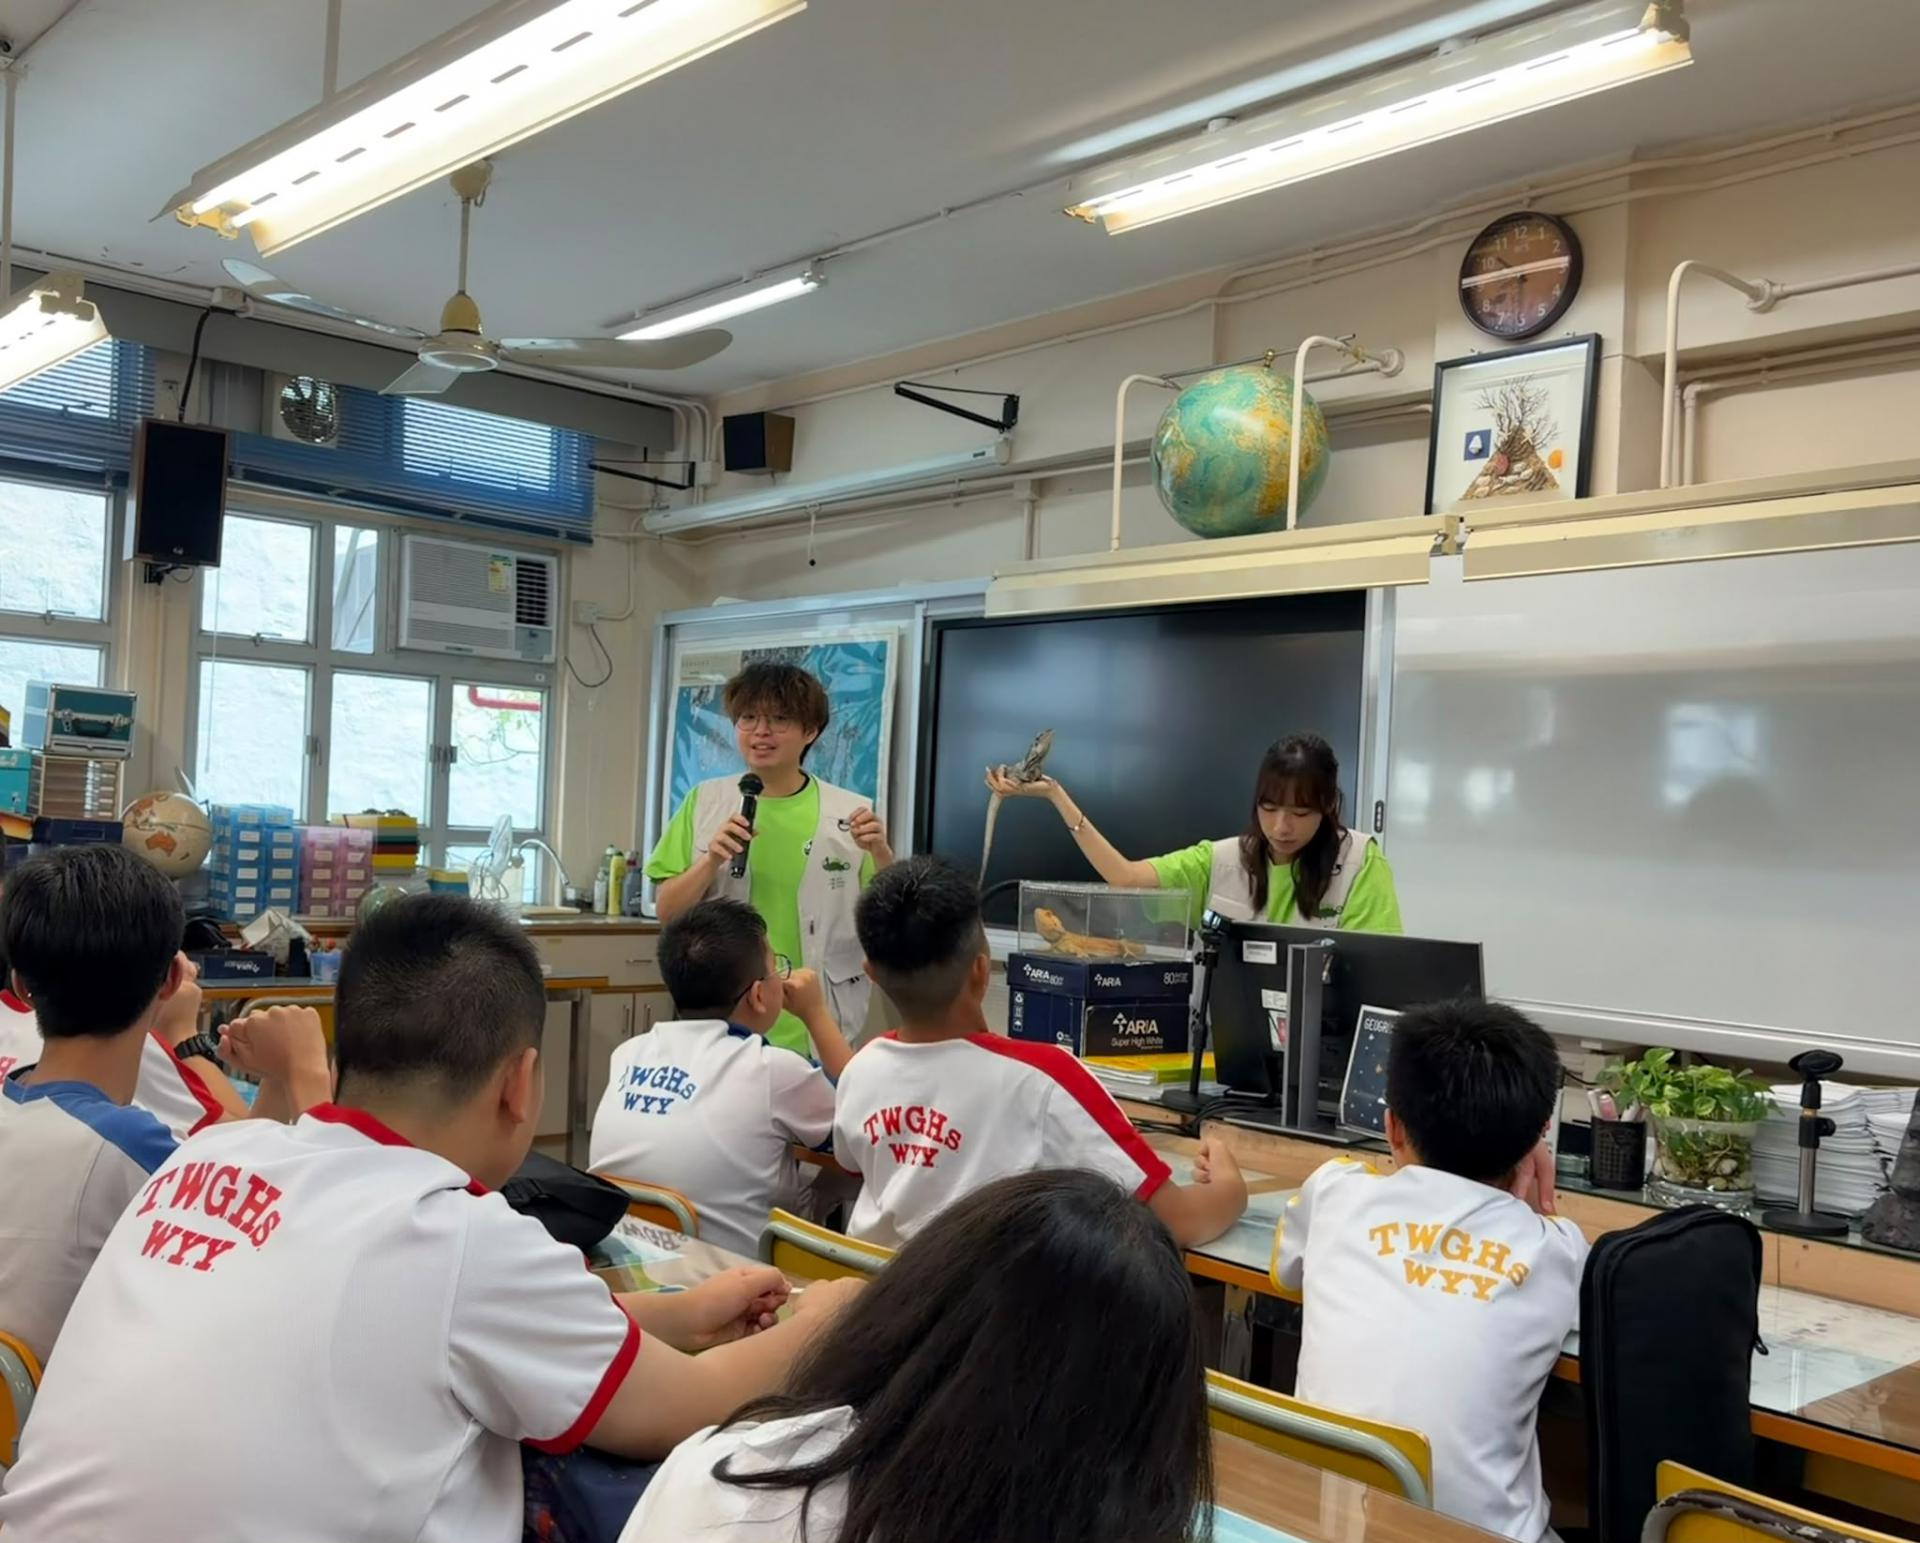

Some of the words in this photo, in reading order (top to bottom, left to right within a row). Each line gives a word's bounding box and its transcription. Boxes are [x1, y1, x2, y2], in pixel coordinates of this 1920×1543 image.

[1514, 225, 1528, 239] 12
[1496, 237, 1508, 251] 11
[1552, 240, 1561, 253] 2
[1481, 257, 1495, 270] 10
[1482, 299, 1491, 312] 8
[1538, 303, 1547, 317] 5
[1101, 976, 1122, 988] ARIA
[1125, 1018, 1159, 1036] ARIA
[1111, 1037, 1130, 1047] Super
[1131, 1037, 1146, 1049] High
